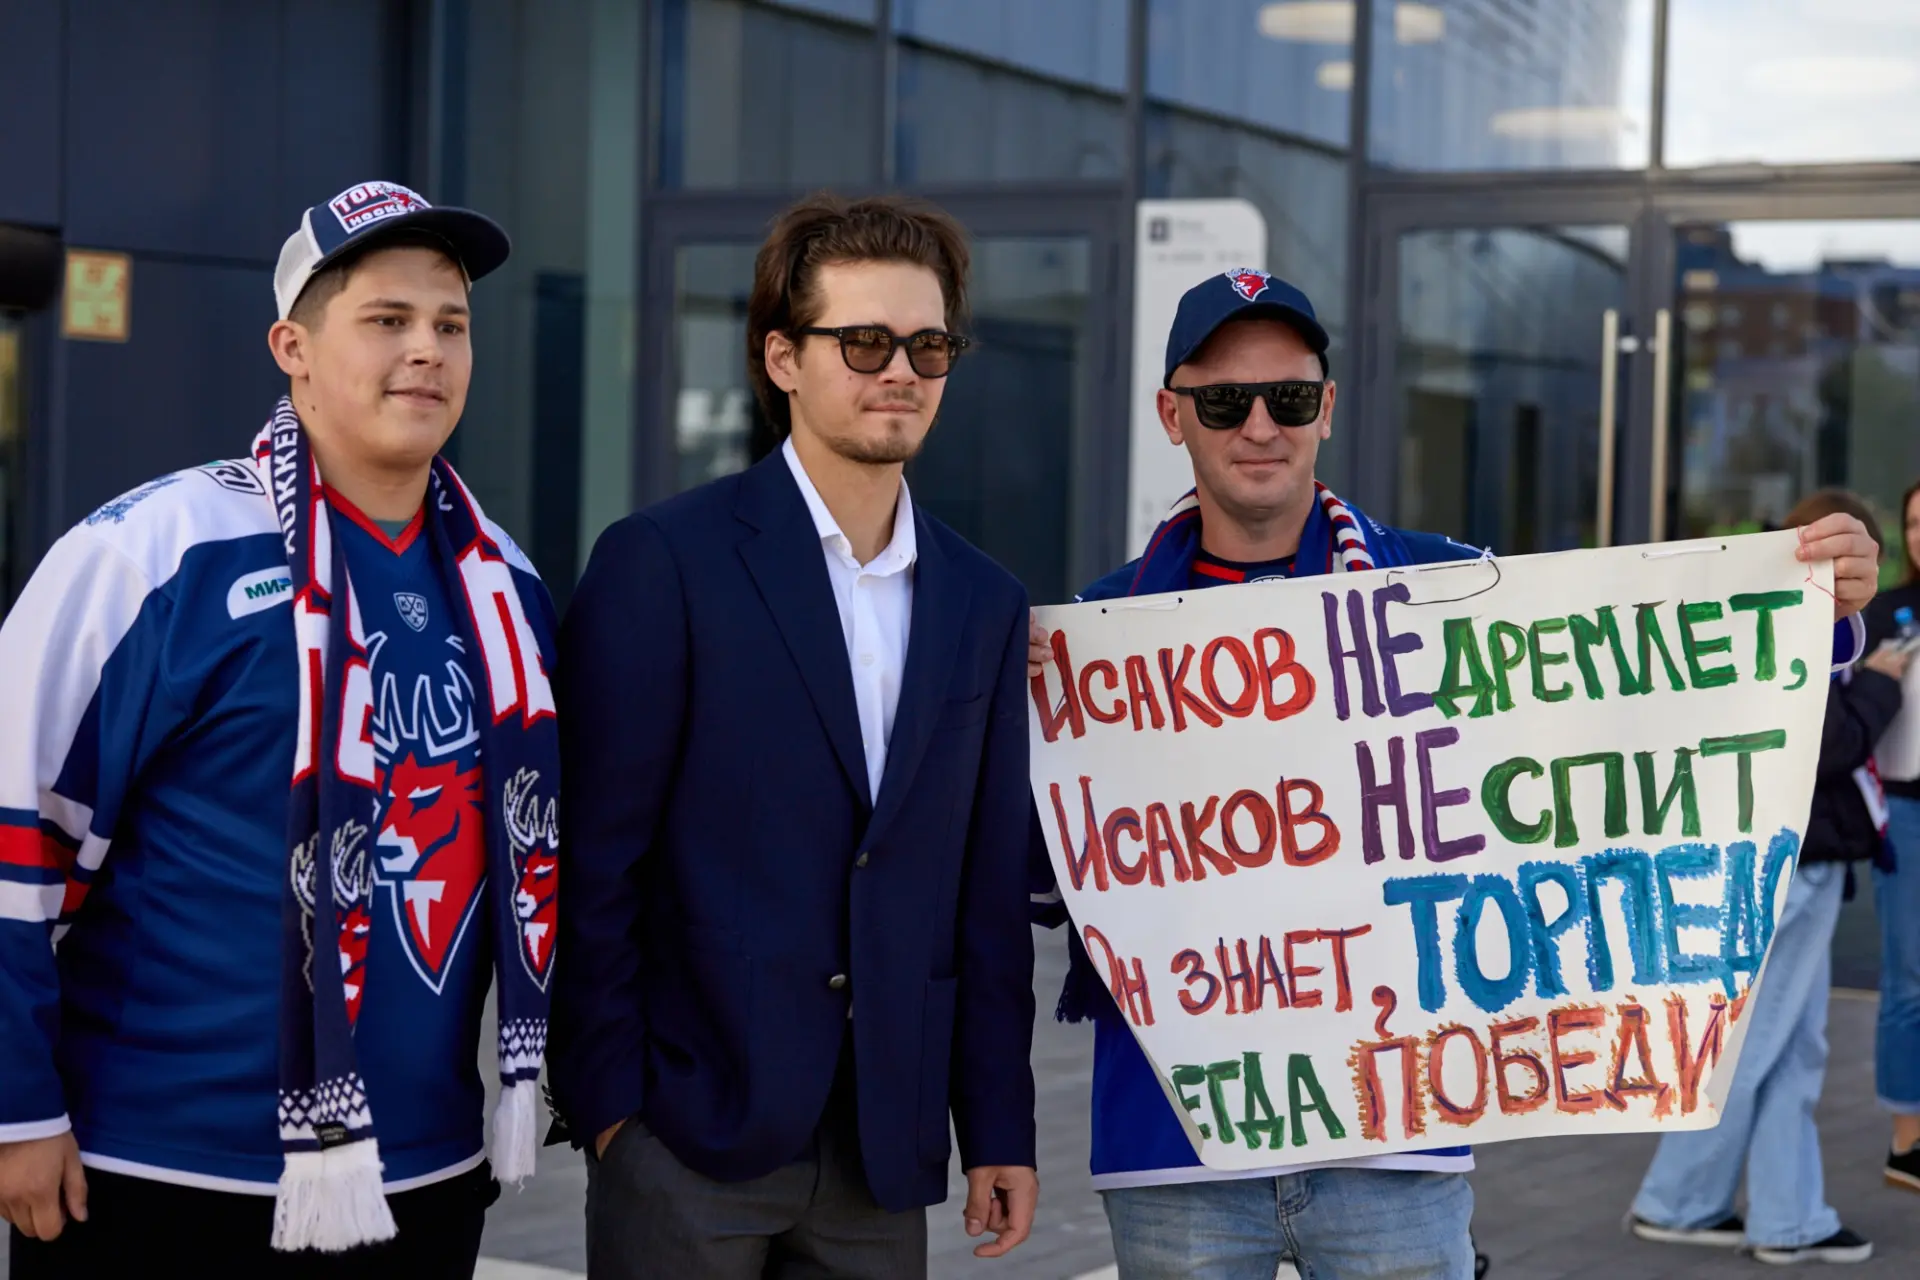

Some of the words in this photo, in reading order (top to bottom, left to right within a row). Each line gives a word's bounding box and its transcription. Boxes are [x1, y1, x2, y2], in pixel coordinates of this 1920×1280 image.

[1322, 583, 1434, 721] НЕ
[1432, 589, 1807, 719] ДРЕМЛЕТ,
[1354, 726, 1486, 865] НЕ
[1481, 728, 1786, 849] СПИТ
[1170, 923, 1398, 1038] ЗНАЕТ,
[1166, 1050, 1347, 1151] ЕГДА
[1346, 984, 1750, 1143] ПОБЕДИ
